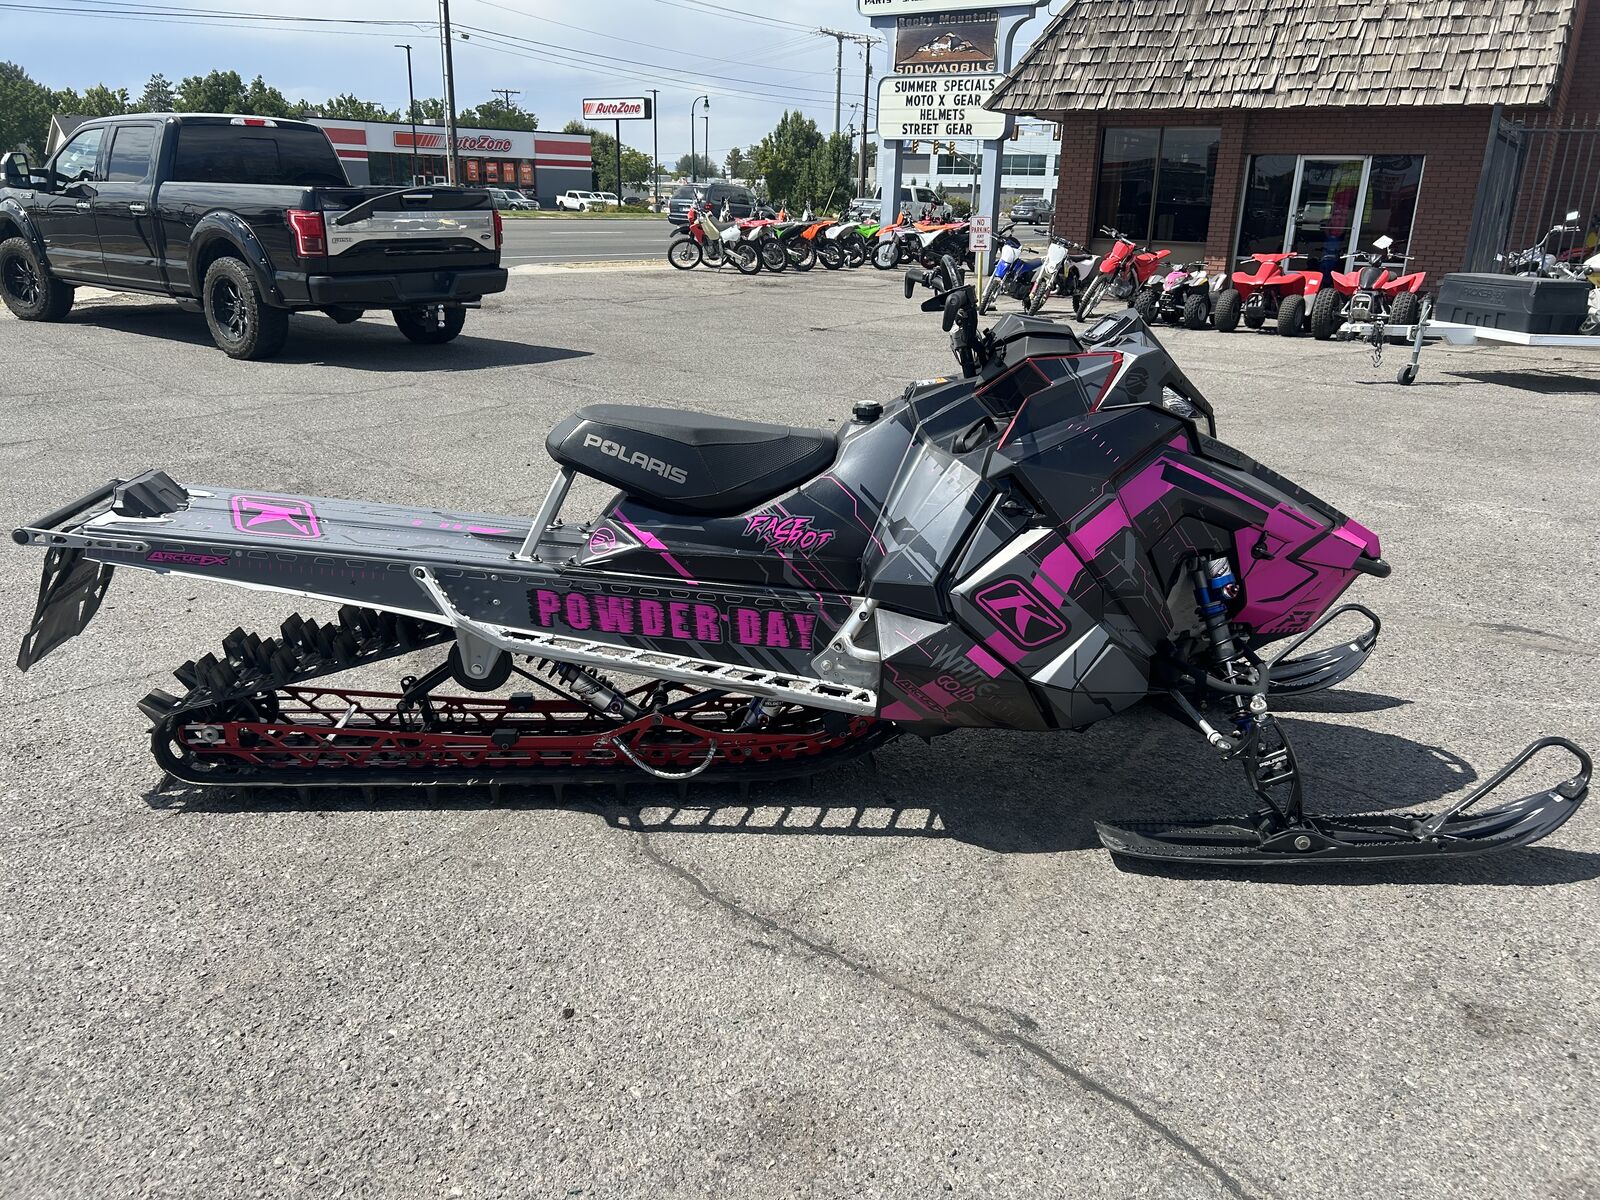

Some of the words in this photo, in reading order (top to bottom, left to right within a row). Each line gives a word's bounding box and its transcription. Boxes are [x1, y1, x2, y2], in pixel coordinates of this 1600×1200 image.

[898, 17, 934, 27] Rocky
[939, 12, 998, 25] Mountain
[896, 62, 995, 74] SNOWMOBILE
[895, 81, 937, 93] SUMMER
[944, 79, 995, 92] SPECIALS
[596, 102, 641, 114] AutoZone
[905, 95, 934, 107] MOTO
[938, 95, 945, 106] X
[953, 94, 981, 106] GEAR
[919, 109, 965, 121] HELMETS
[902, 123, 938, 135] STREET
[946, 123, 973, 135] GEAR
[446, 135, 512, 152] utoZone
[583, 433, 688, 484] POLARIS
[746, 516, 812, 534] FACE
[769, 530, 833, 549] SHOT
[533, 589, 721, 642] POWDER
[737, 608, 817, 649] DAY
[936, 674, 976, 702] GOLD
